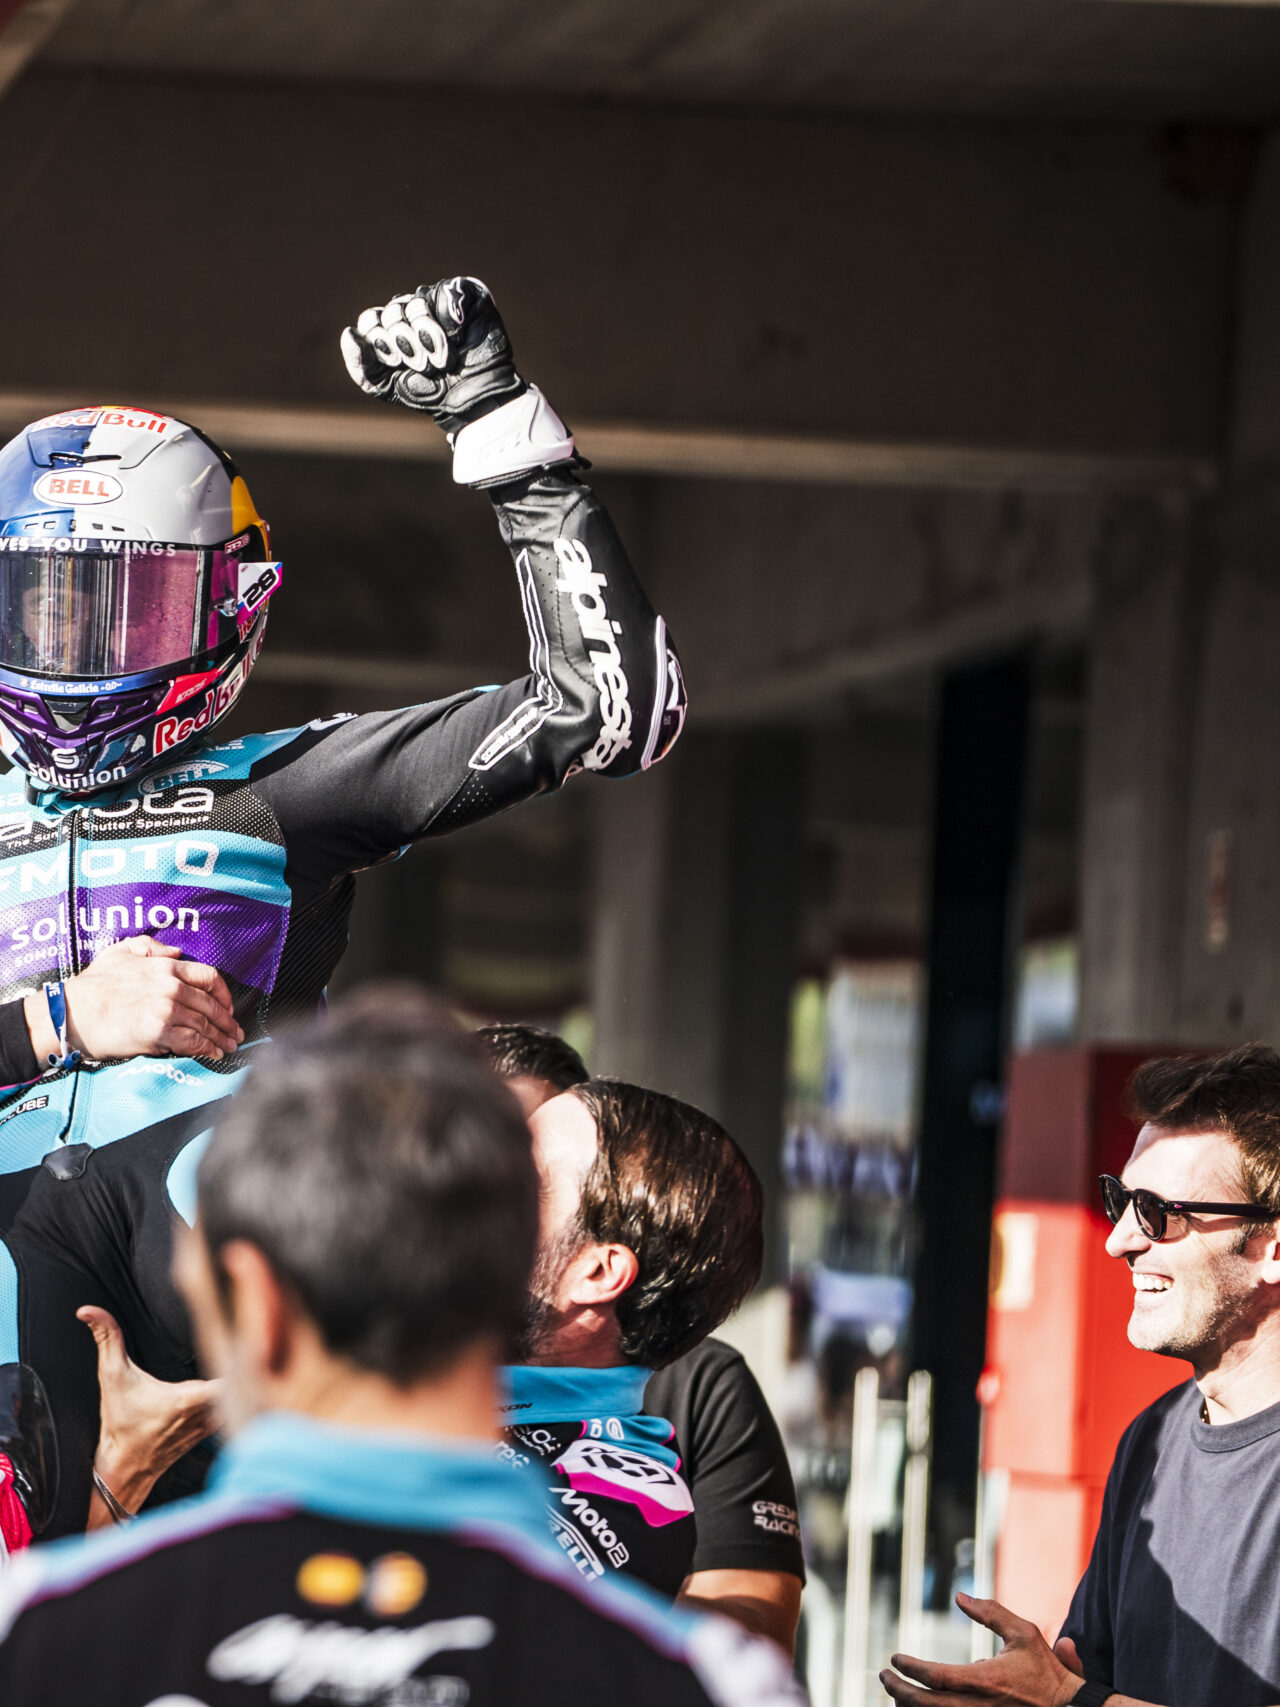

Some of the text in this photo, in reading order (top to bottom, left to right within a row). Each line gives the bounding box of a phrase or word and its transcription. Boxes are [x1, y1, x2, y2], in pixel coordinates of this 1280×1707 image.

[32, 411, 168, 434] Red Bull
[48, 478, 110, 498] BELL
[43, 537, 88, 552] YOU
[101, 539, 177, 557] WINGS
[242, 567, 278, 609] 28
[29, 681, 65, 693] Estrella
[65, 683, 100, 694] Galicia
[153, 688, 215, 758] Red
[28, 762, 127, 789] solunion
[34, 829, 58, 841] Sun
[82, 819, 135, 832] Shutter
[136, 815, 210, 830] Specialists
[10, 896, 200, 951] solunion
